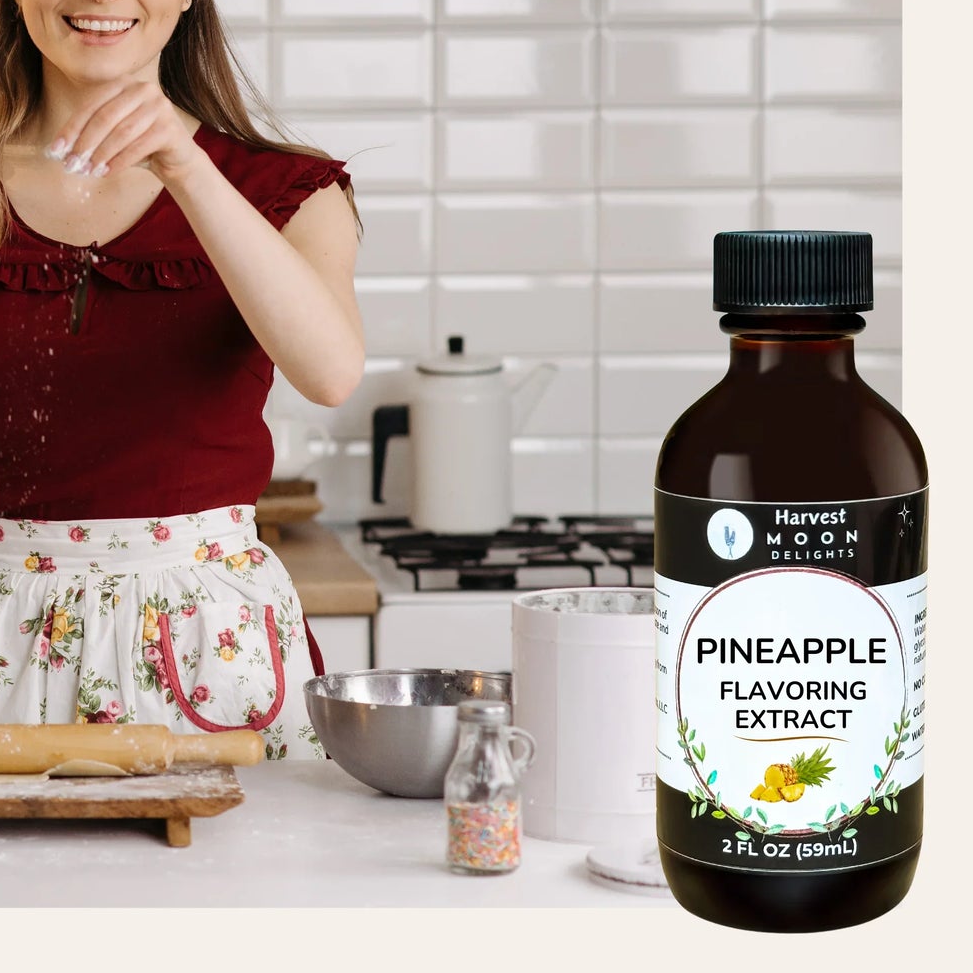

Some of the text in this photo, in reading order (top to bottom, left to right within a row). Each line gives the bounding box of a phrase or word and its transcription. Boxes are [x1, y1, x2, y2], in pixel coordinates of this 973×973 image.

[775, 507, 846, 525] Harvest
[771, 548, 854, 560] DELIGHTS
[697, 638, 887, 664] PINEAPPLE
[720, 681, 867, 701] FLAVORING
[735, 710, 853, 729] EXTRACT
[722, 838, 858, 861] 2 FL OZ (59mL)
